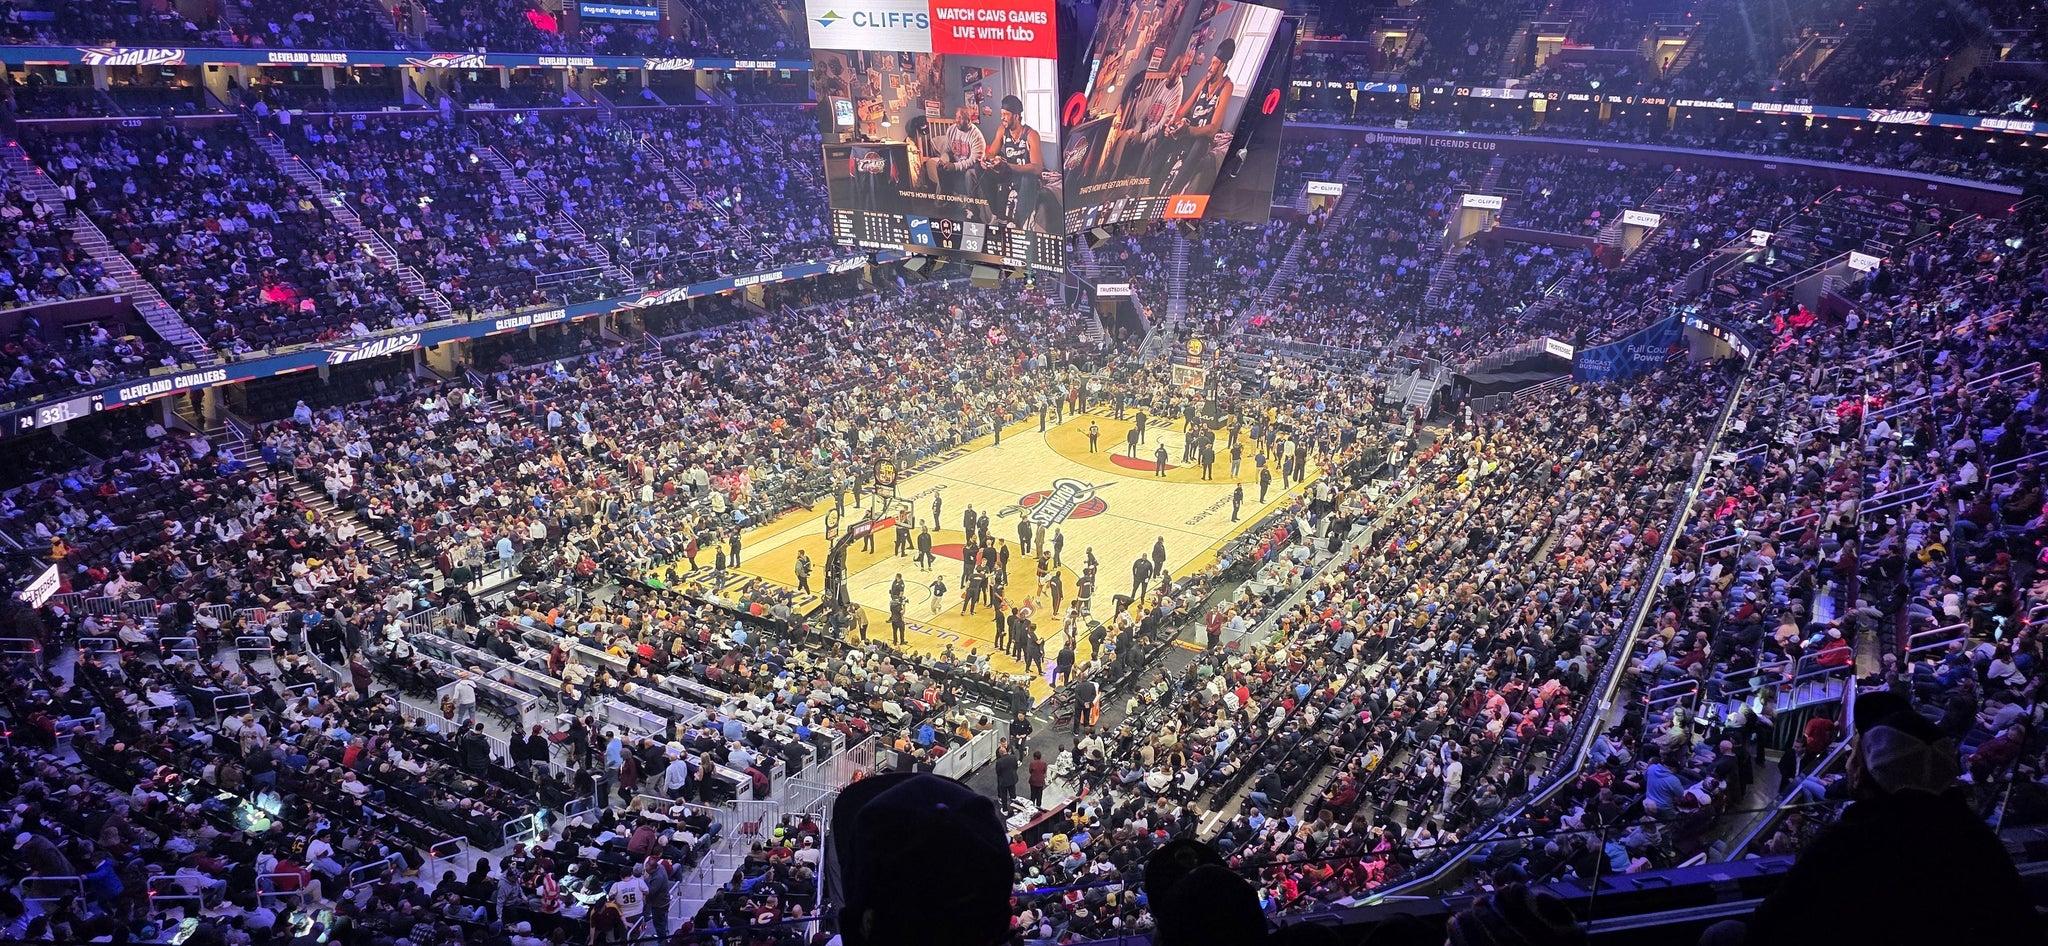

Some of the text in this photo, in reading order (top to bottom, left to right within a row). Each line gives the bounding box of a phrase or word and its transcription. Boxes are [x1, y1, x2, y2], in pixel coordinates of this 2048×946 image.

[852, 11, 929, 29] CLIFFS
[936, 8, 1047, 24] WATCH CAVS GAMES
[953, 26, 1034, 41] LIVE WITH fubo
[269, 52, 347, 63] CLEVELAND CAVALIERS
[539, 57, 594, 66] CLEVELAND CAVALIERS
[735, 60, 755, 69] CLEVELAND
[1457, 88, 1470, 96] 2Q
[1481, 89, 1492, 97] 33
[1752, 102, 1782, 112] CLEVELAND
[1377, 133, 1422, 146] Huntington
[1430, 139, 1496, 151] LEGENDS CLUB
[1175, 201, 1196, 214] fubo
[916, 234, 928, 244] 19
[966, 240, 978, 250] 33
[735, 278, 758, 287] CLEVELAND
[496, 309, 566, 330] CLEVELAND CAVALIERS
[1628, 344, 1645, 353] Full
[1580, 358, 1612, 366] COMCAST
[1634, 354, 1664, 362] Power
[1579, 364, 1610, 372] BUSINESS
[120, 370, 226, 400] CLEVELAND CAVALIERS
[95, 402, 102, 412] 0
[42, 408, 60, 424] 33
[20, 416, 34, 428] 24
